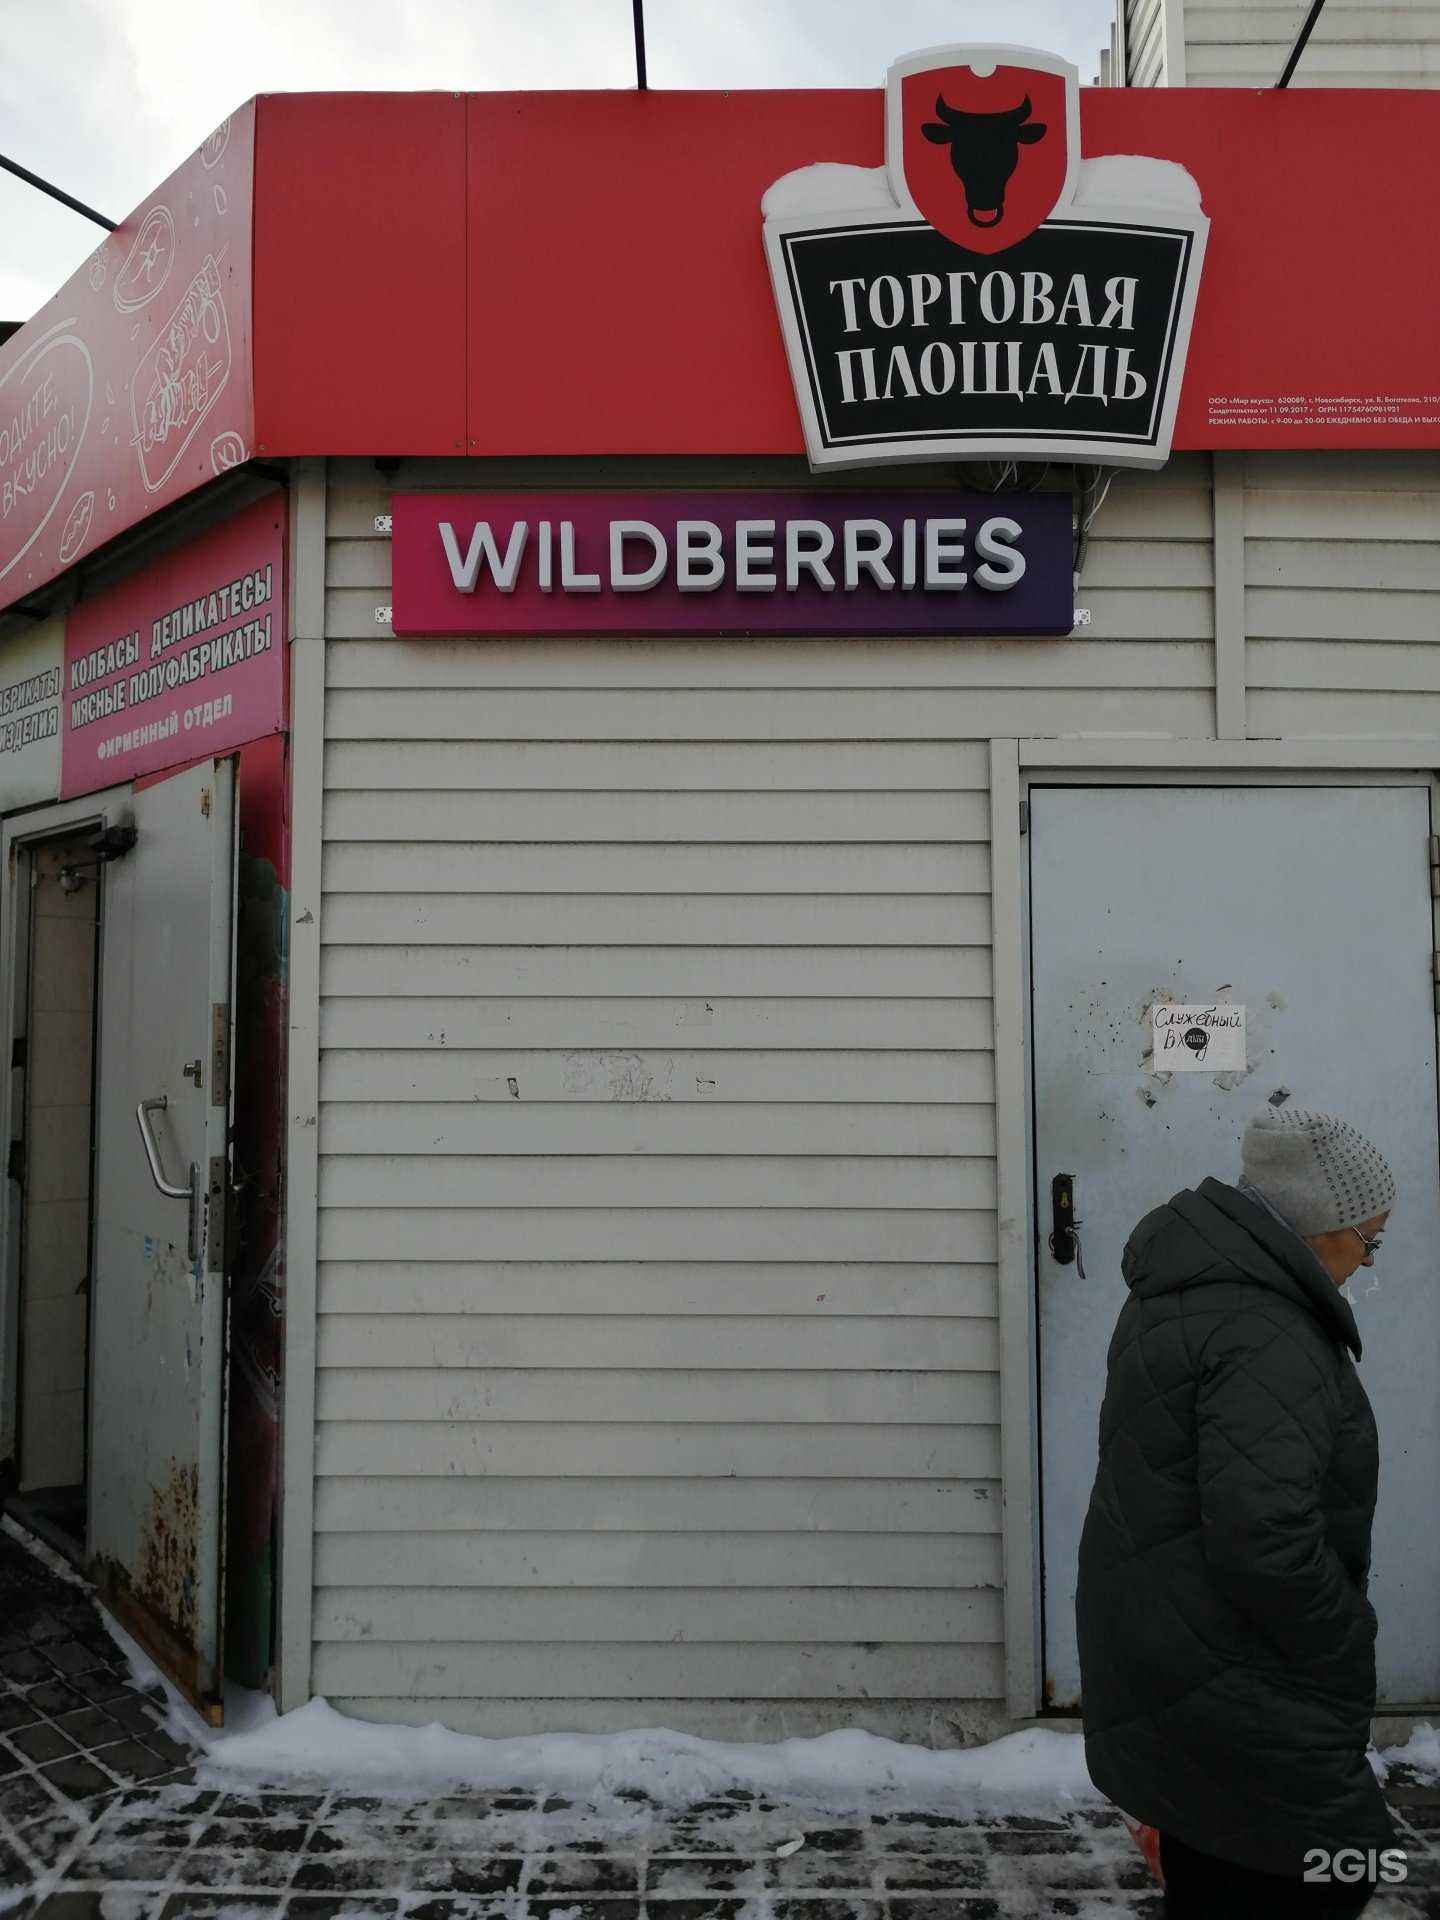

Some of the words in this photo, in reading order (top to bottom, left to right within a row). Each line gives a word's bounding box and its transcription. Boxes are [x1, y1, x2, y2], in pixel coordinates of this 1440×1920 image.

[829, 271, 1140, 333] ТОРГОВАЯ
[834, 341, 1148, 407] ПЛОЩАДЬ
[1315, 396, 1362, 405] Новосибирск,
[437, 516, 1027, 594] WILDBERRIES
[71, 630, 140, 692] КОЛБАСЫ
[150, 563, 272, 660] ДЕЛИКАТЕСЫ
[71, 677, 125, 731] МЯСНЫЕ
[129, 613, 272, 706] ПОЛУФАБРИКАТЫ
[97, 711, 179, 760] ФИРМЕННЫЙ
[183, 694, 233, 730] ОТДЕЛ
[1155, 1007, 1242, 1028] Служебный
